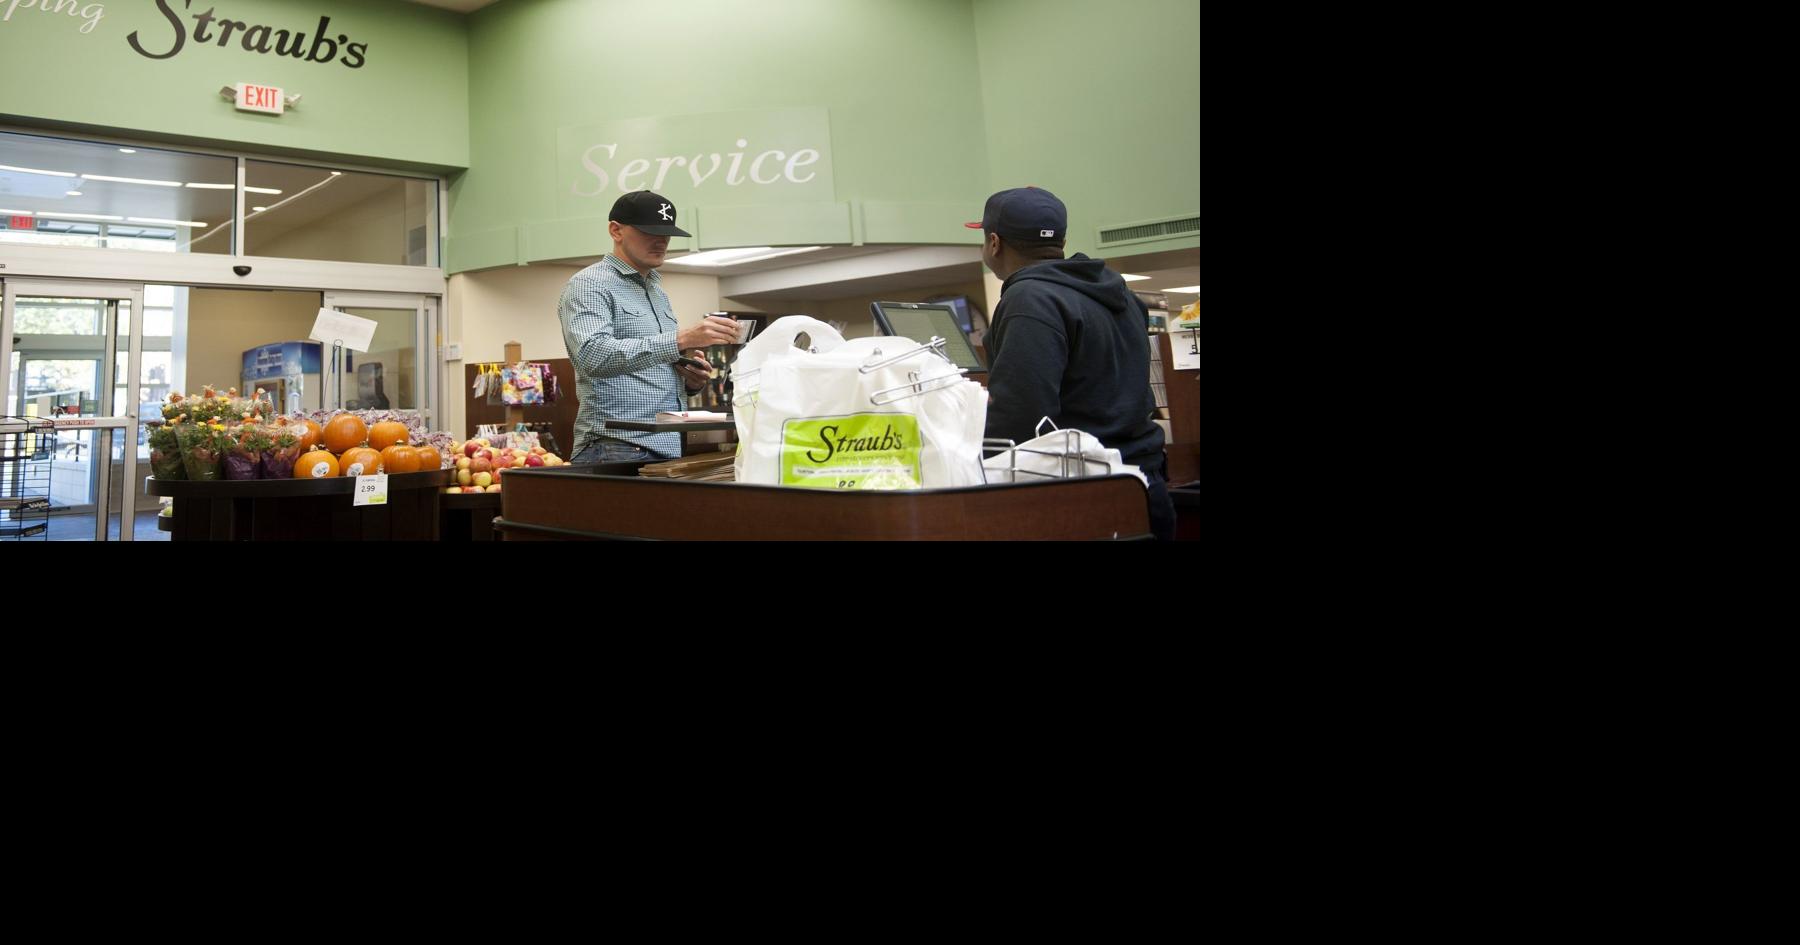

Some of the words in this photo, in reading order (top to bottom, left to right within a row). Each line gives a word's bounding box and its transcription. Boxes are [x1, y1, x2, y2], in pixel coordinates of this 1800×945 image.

[126, 0, 368, 69] Straub's
[245, 85, 278, 109] EXIT
[571, 138, 820, 197] Service
[806, 424, 903, 463] Straub's
[361, 485, 376, 493] 2.99
